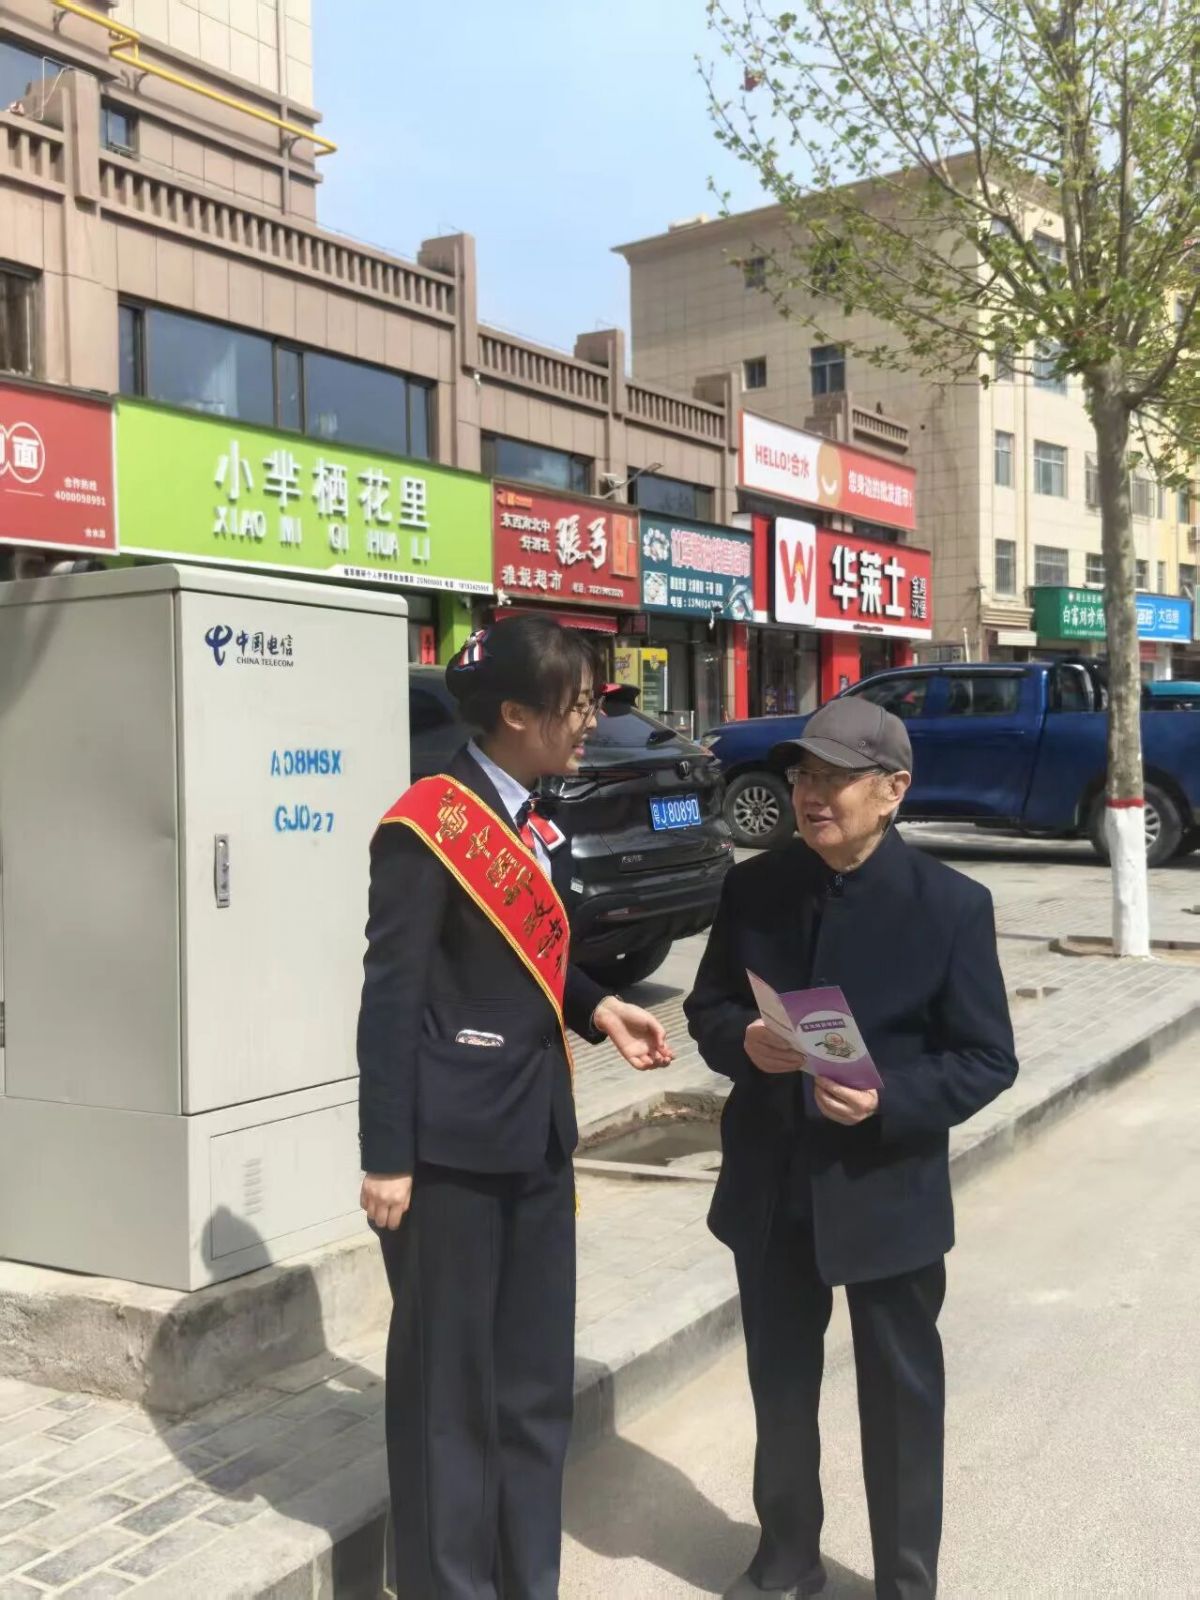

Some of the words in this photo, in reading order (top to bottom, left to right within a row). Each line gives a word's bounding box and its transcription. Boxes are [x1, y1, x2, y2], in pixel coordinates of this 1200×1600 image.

[213, 506, 267, 539] XIAO
[280, 515, 302, 546] MI
[328, 523, 349, 554] QI
[365, 529, 400, 561] HUA
[411, 536, 431, 565] LI
[832, 544, 906, 618] 华莱士
[236, 630, 293, 656] 中国电信
[236, 656, 260, 666] CHINA
[261, 658, 294, 667] TELECOM
